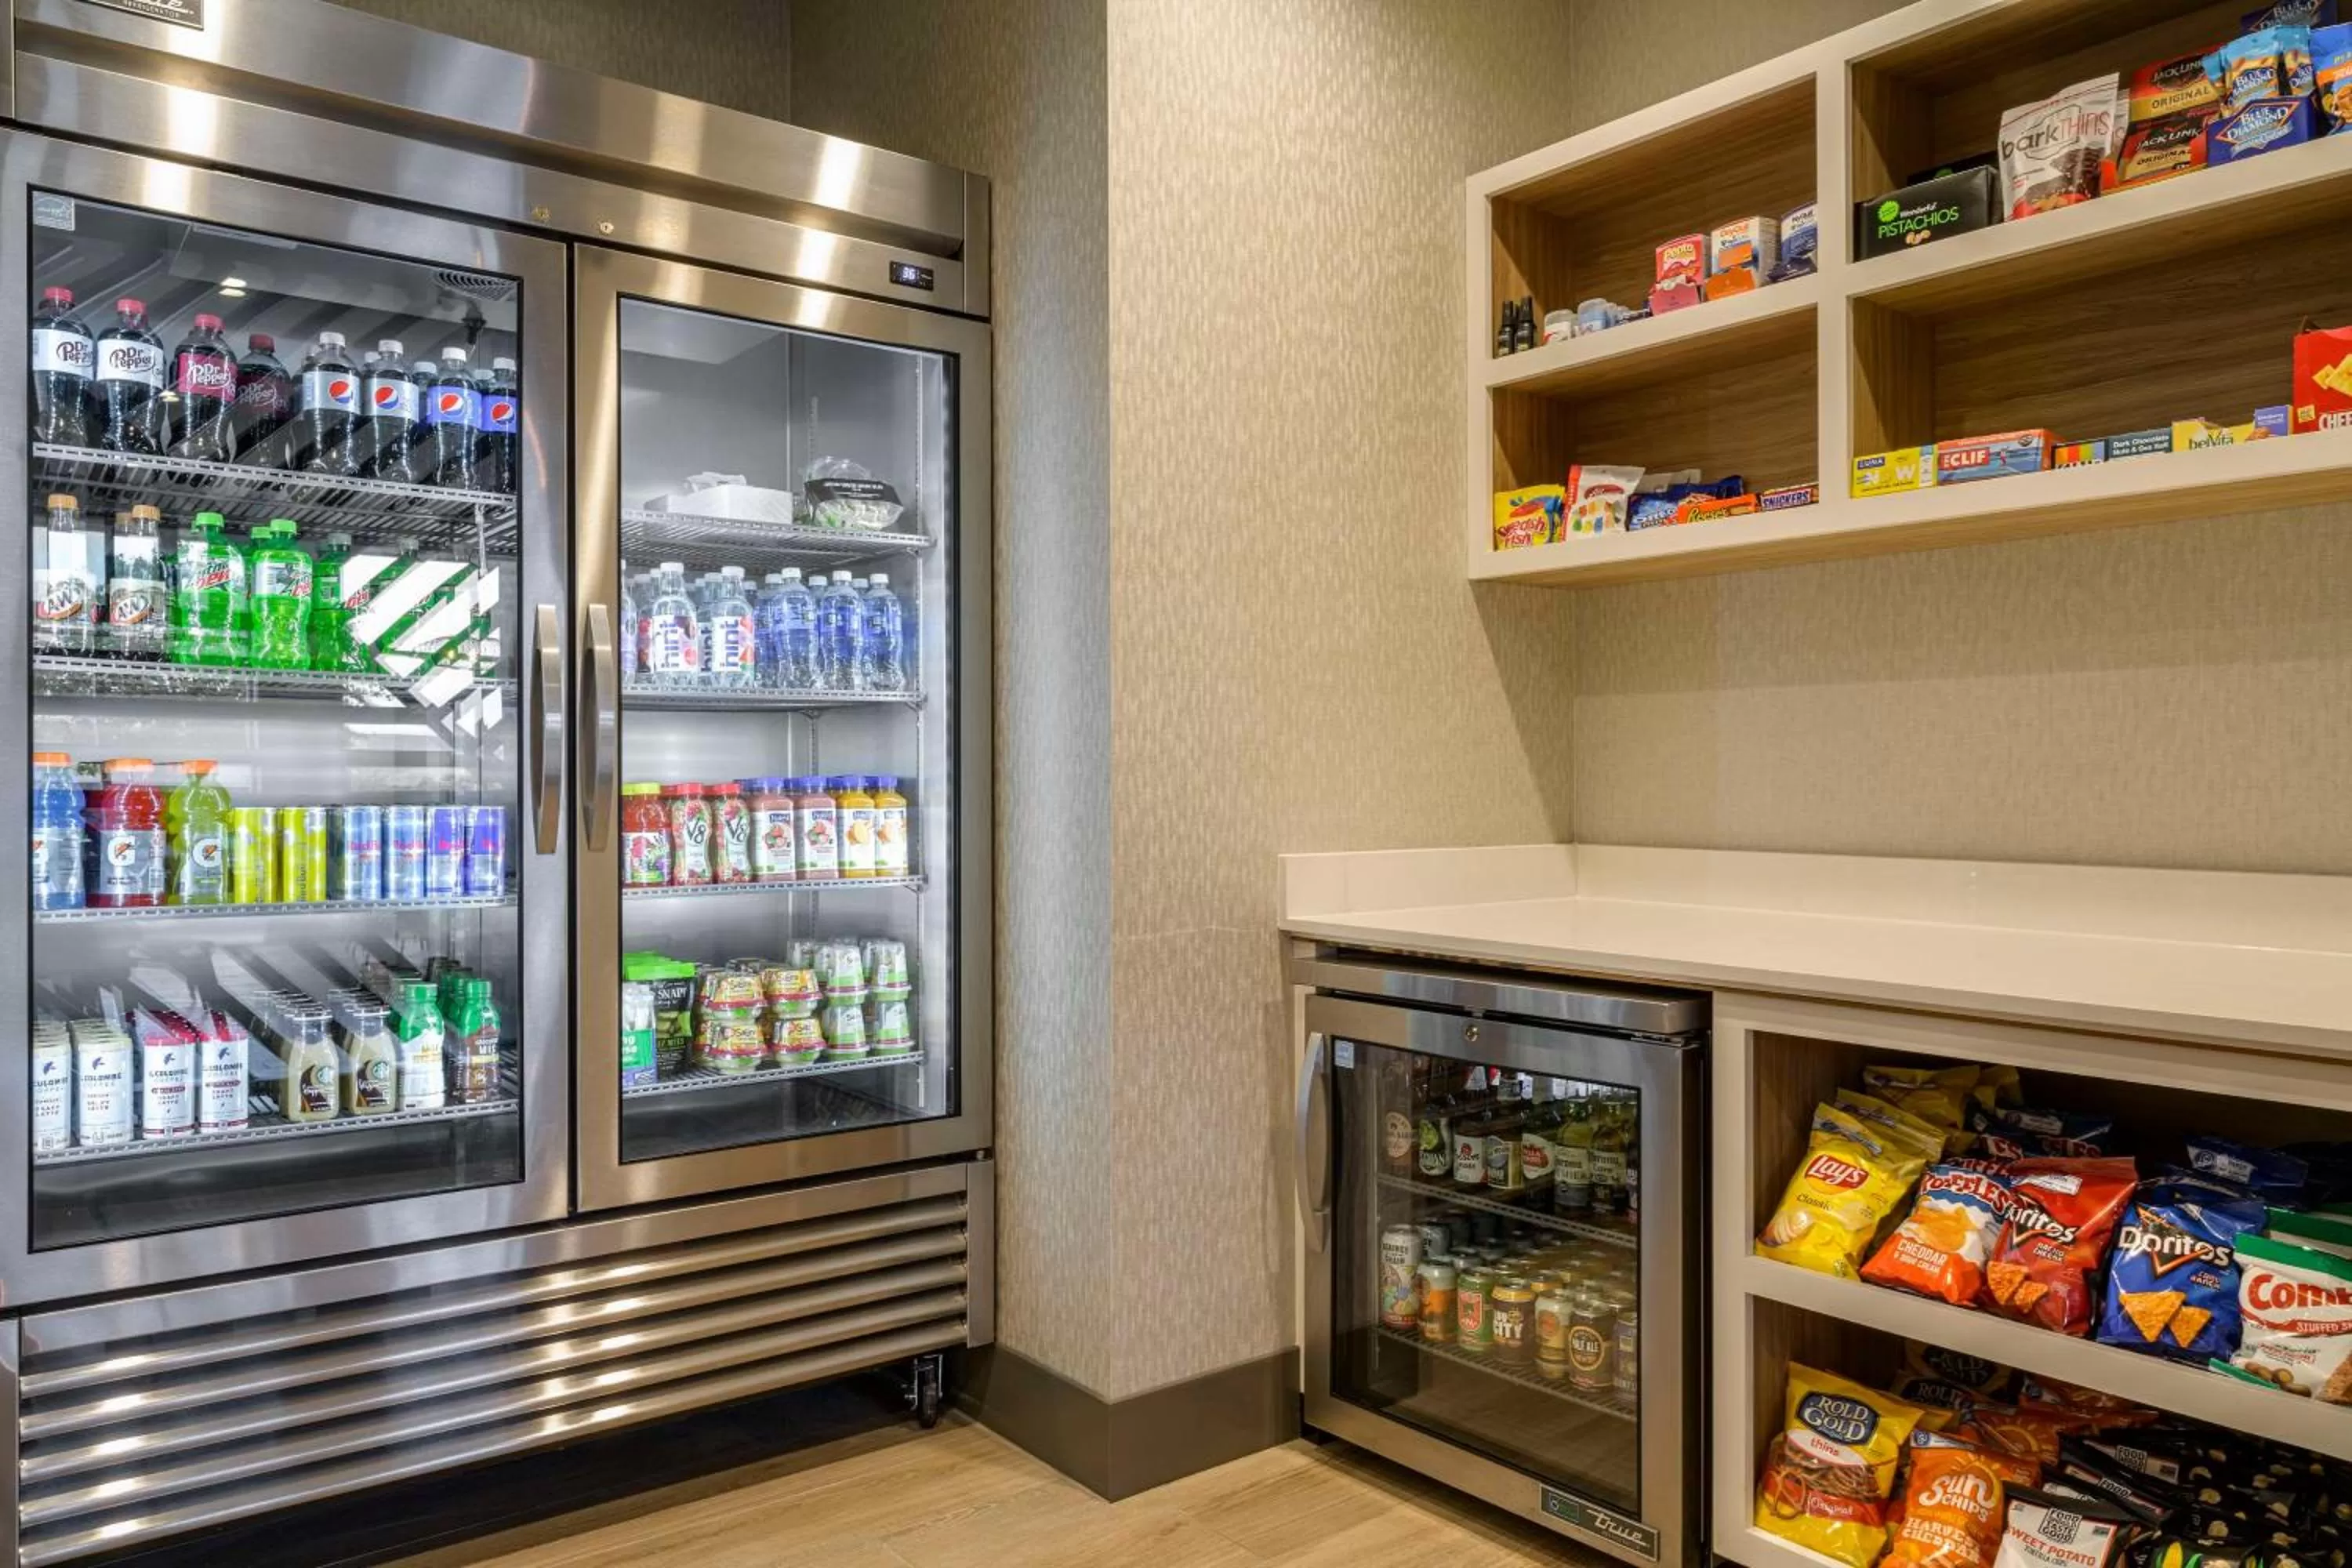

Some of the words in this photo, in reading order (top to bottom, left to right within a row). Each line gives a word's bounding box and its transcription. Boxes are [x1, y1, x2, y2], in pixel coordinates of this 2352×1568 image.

[2152, 67, 2180, 83] JACK
[2152, 86, 2209, 108] ORIGINAL
[2227, 107, 2288, 140] DIAMOND
[2241, 107, 2269, 125] BLUE
[2136, 134, 2167, 151] JACK
[1878, 206, 1960, 239] PISTACHIOS
[110, 347, 152, 369] Pepper
[125, 347, 143, 360] Dr
[189, 360, 230, 385] Pepper
[204, 362, 222, 375] Dr
[2188, 431, 2234, 449] belVita
[1950, 449, 1987, 466] CLIF
[1763, 491, 1810, 508] SNICKERS
[719, 618, 739, 668] hint
[685, 818, 707, 844] V8
[725, 817, 746, 843] V8
[1808, 1154, 1869, 1186] Lay's
[1896, 1239, 1948, 1265] CHEDDAR
[2118, 1225, 2234, 1268] Doritos
[2296, 1322, 2339, 1333] STUFFED
[1818, 1395, 1870, 1424] ROLD
[1802, 1407, 1866, 1442] GOLD
[1809, 1436, 1841, 1457] thins
[1919, 1472, 1996, 1508] Sun
[1941, 1492, 1990, 1523] CHIPS
[2047, 1545, 2096, 1566] POTATO
